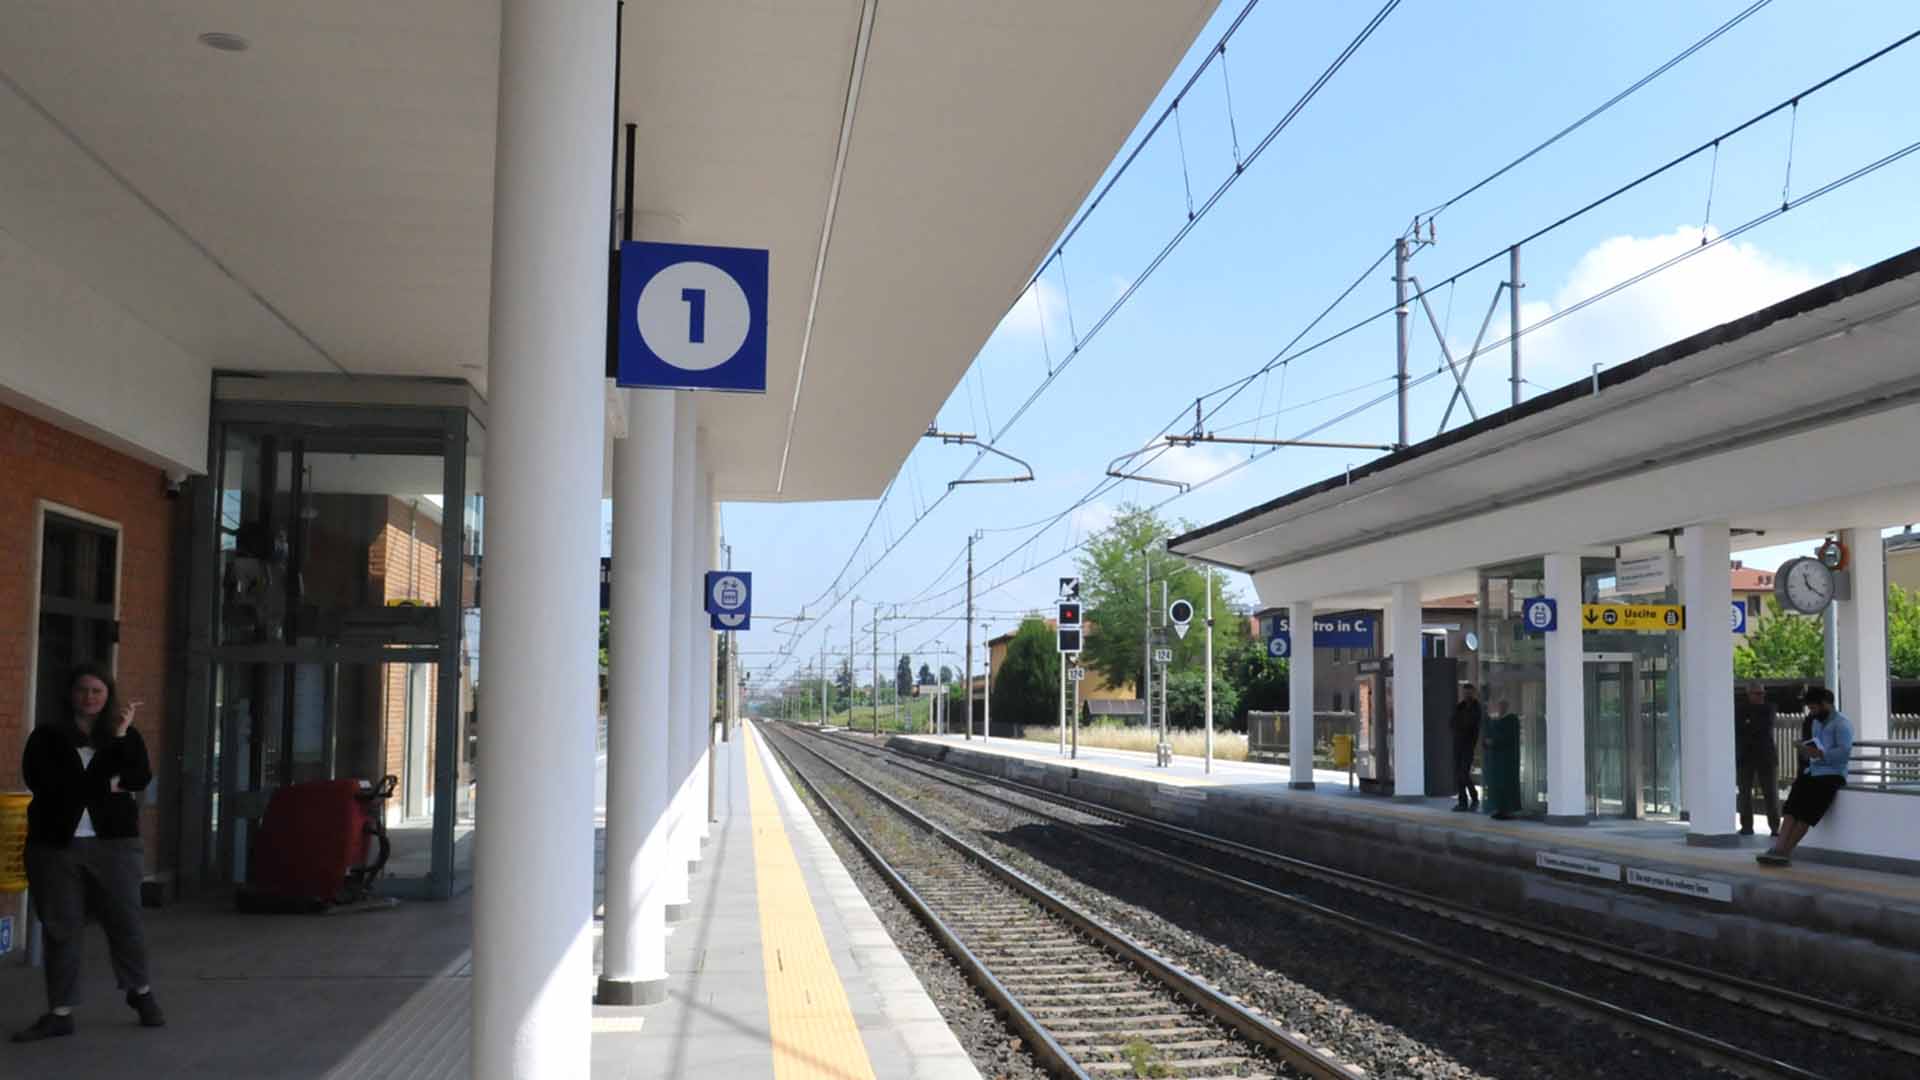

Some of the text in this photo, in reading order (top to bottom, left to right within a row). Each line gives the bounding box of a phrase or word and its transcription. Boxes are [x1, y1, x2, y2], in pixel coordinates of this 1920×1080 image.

[681, 288, 706, 344] 1
[1337, 620, 1350, 632] in
[1354, 619, 1367, 632] C.
[1274, 641, 1283, 651] 2
